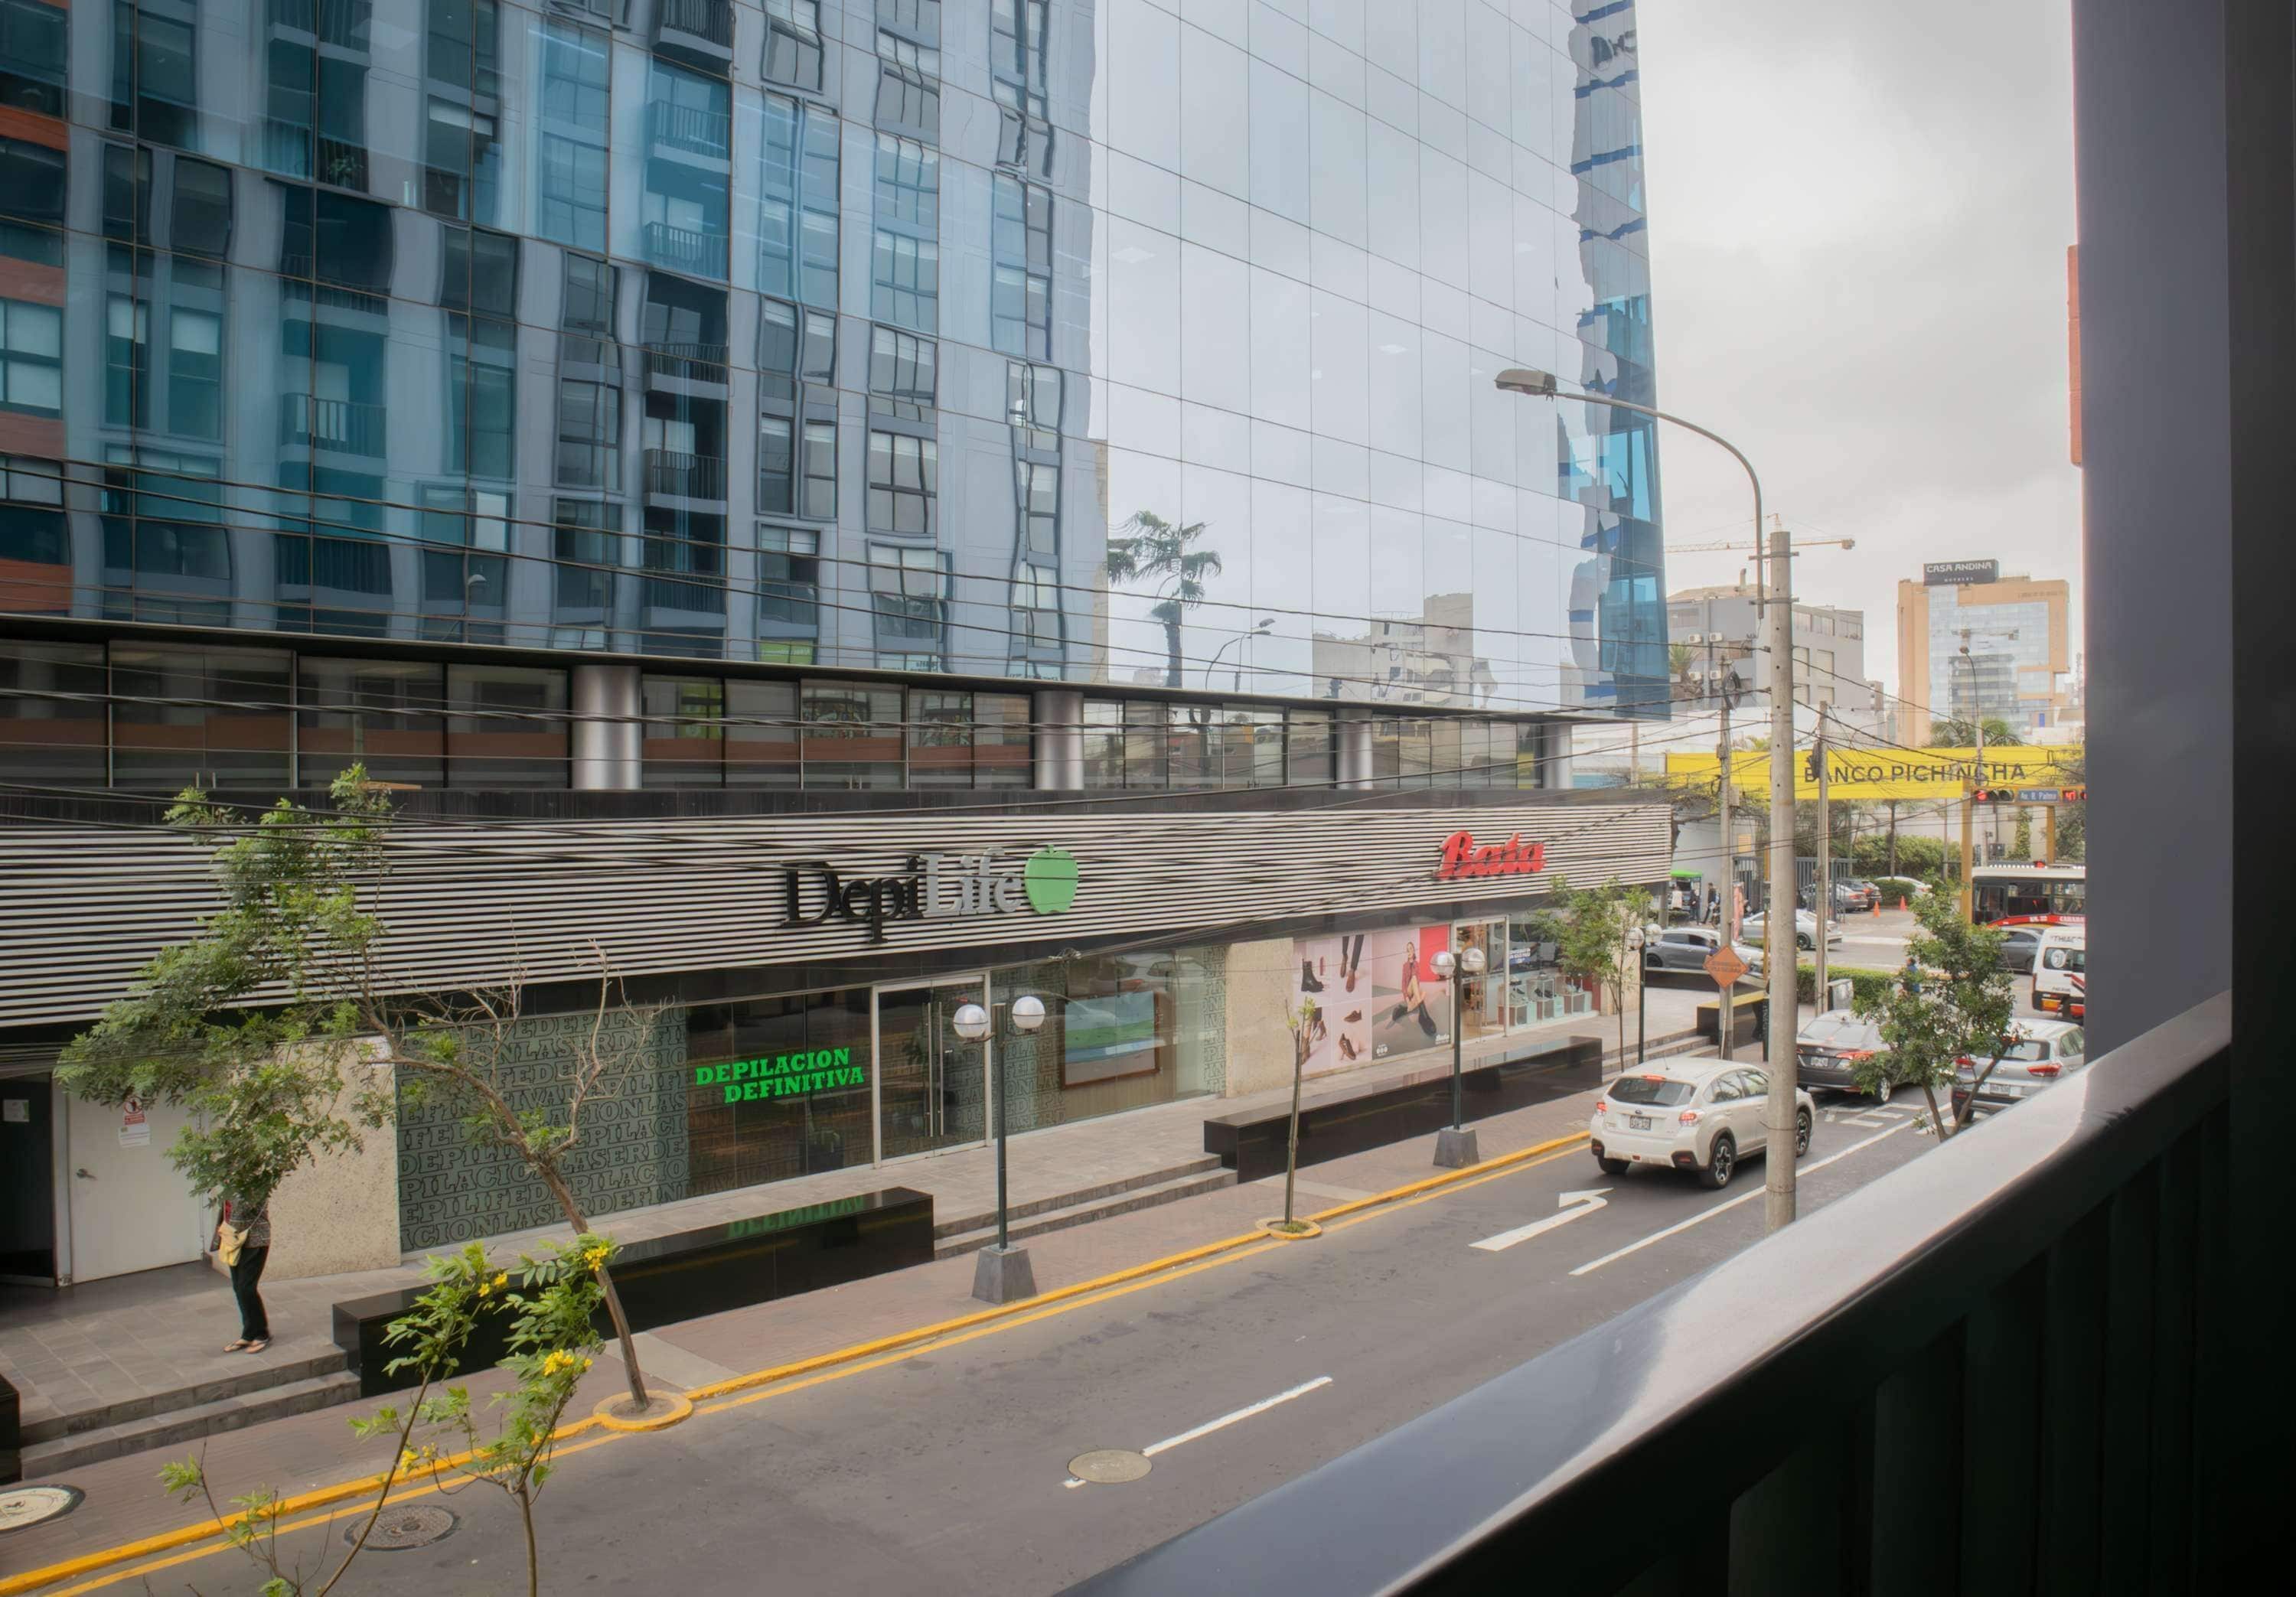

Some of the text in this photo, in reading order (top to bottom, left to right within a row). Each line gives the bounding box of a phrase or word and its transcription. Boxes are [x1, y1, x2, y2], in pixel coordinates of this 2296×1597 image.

[1926, 562, 1992, 573] CASA ANDINA
[1434, 830, 1547, 880] Bata
[781, 846, 1022, 944] DepiLife
[696, 1048, 850, 1085] DEPILACION
[724, 1067, 864, 1103] DEFINITIVA
